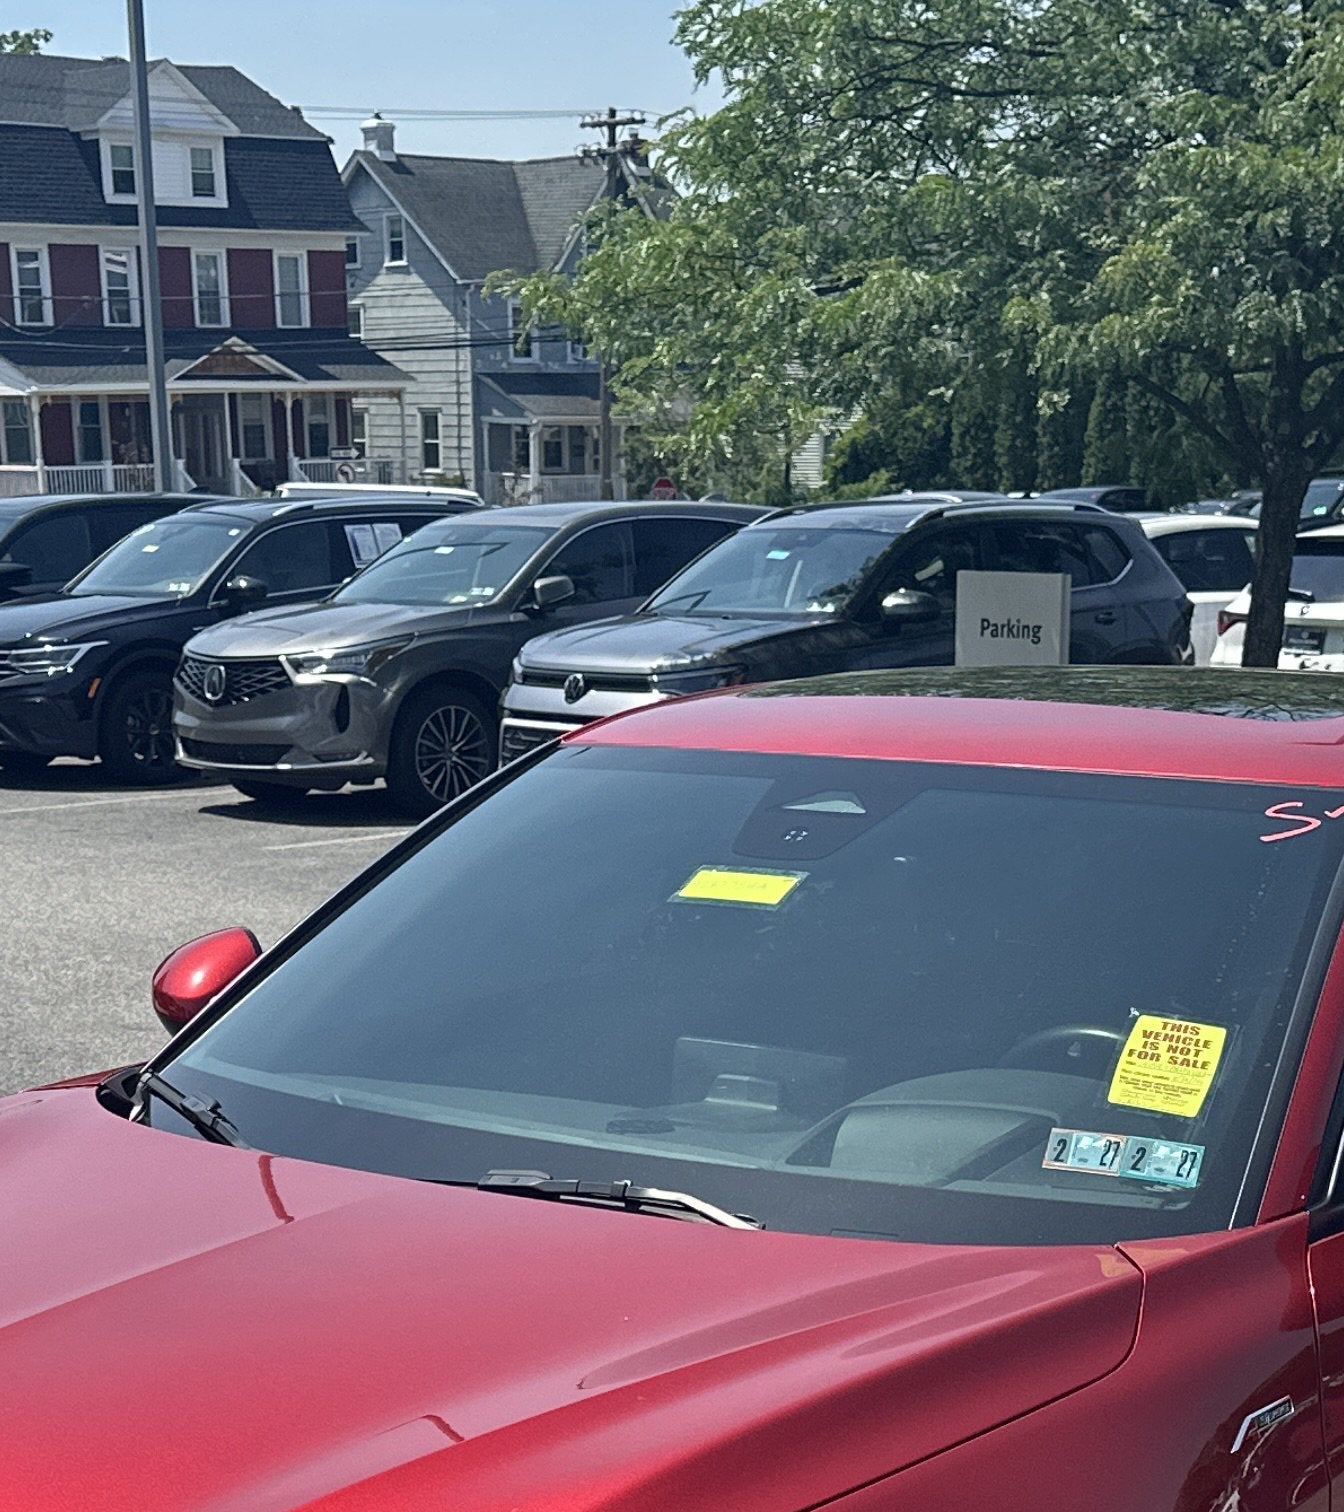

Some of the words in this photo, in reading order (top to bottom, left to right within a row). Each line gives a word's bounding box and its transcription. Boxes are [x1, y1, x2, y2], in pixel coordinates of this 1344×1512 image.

[980, 618, 1043, 645] Parking
[1142, 1029, 1213, 1050] VEHICLE
[1161, 1021, 1201, 1036] THIS
[1127, 1048, 1162, 1062] FOR
[1167, 1055, 1211, 1070] SALE
[1141, 1040, 1160, 1051] IS
[1166, 1043, 1204, 1058] NOT
[1053, 1138, 1068, 1163] 2
[1099, 1139, 1121, 1170] 27
[1131, 1146, 1147, 1172] 2
[1175, 1149, 1198, 1180] 27
